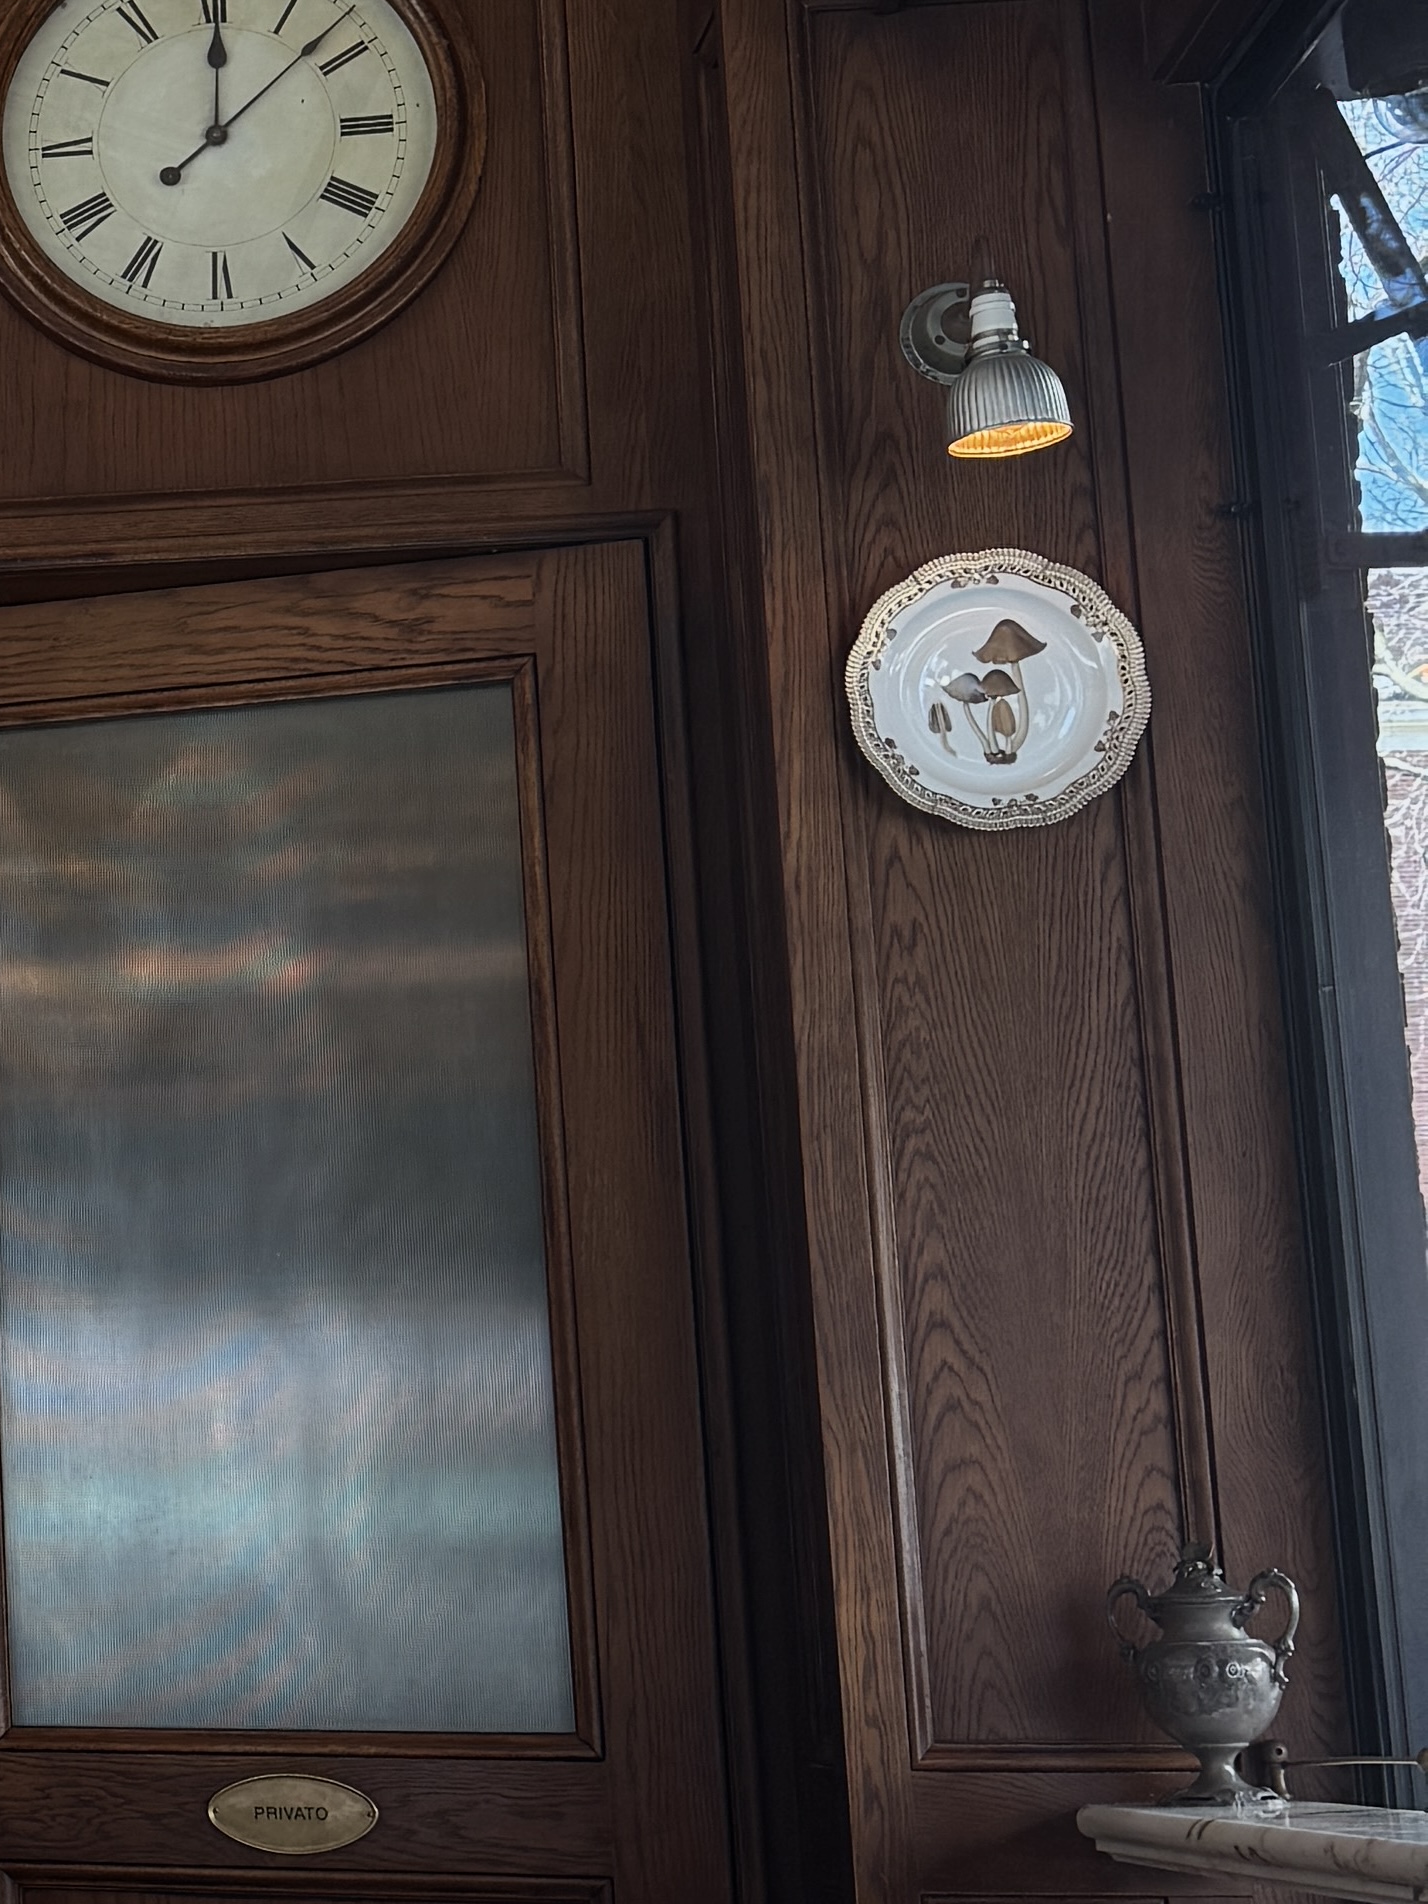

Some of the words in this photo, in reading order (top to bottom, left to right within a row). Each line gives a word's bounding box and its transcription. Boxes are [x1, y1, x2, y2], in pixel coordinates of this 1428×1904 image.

[318, 39, 370, 77] II
[339, 113, 395, 138] III
[254, 1805, 329, 1821] PRIVATO
